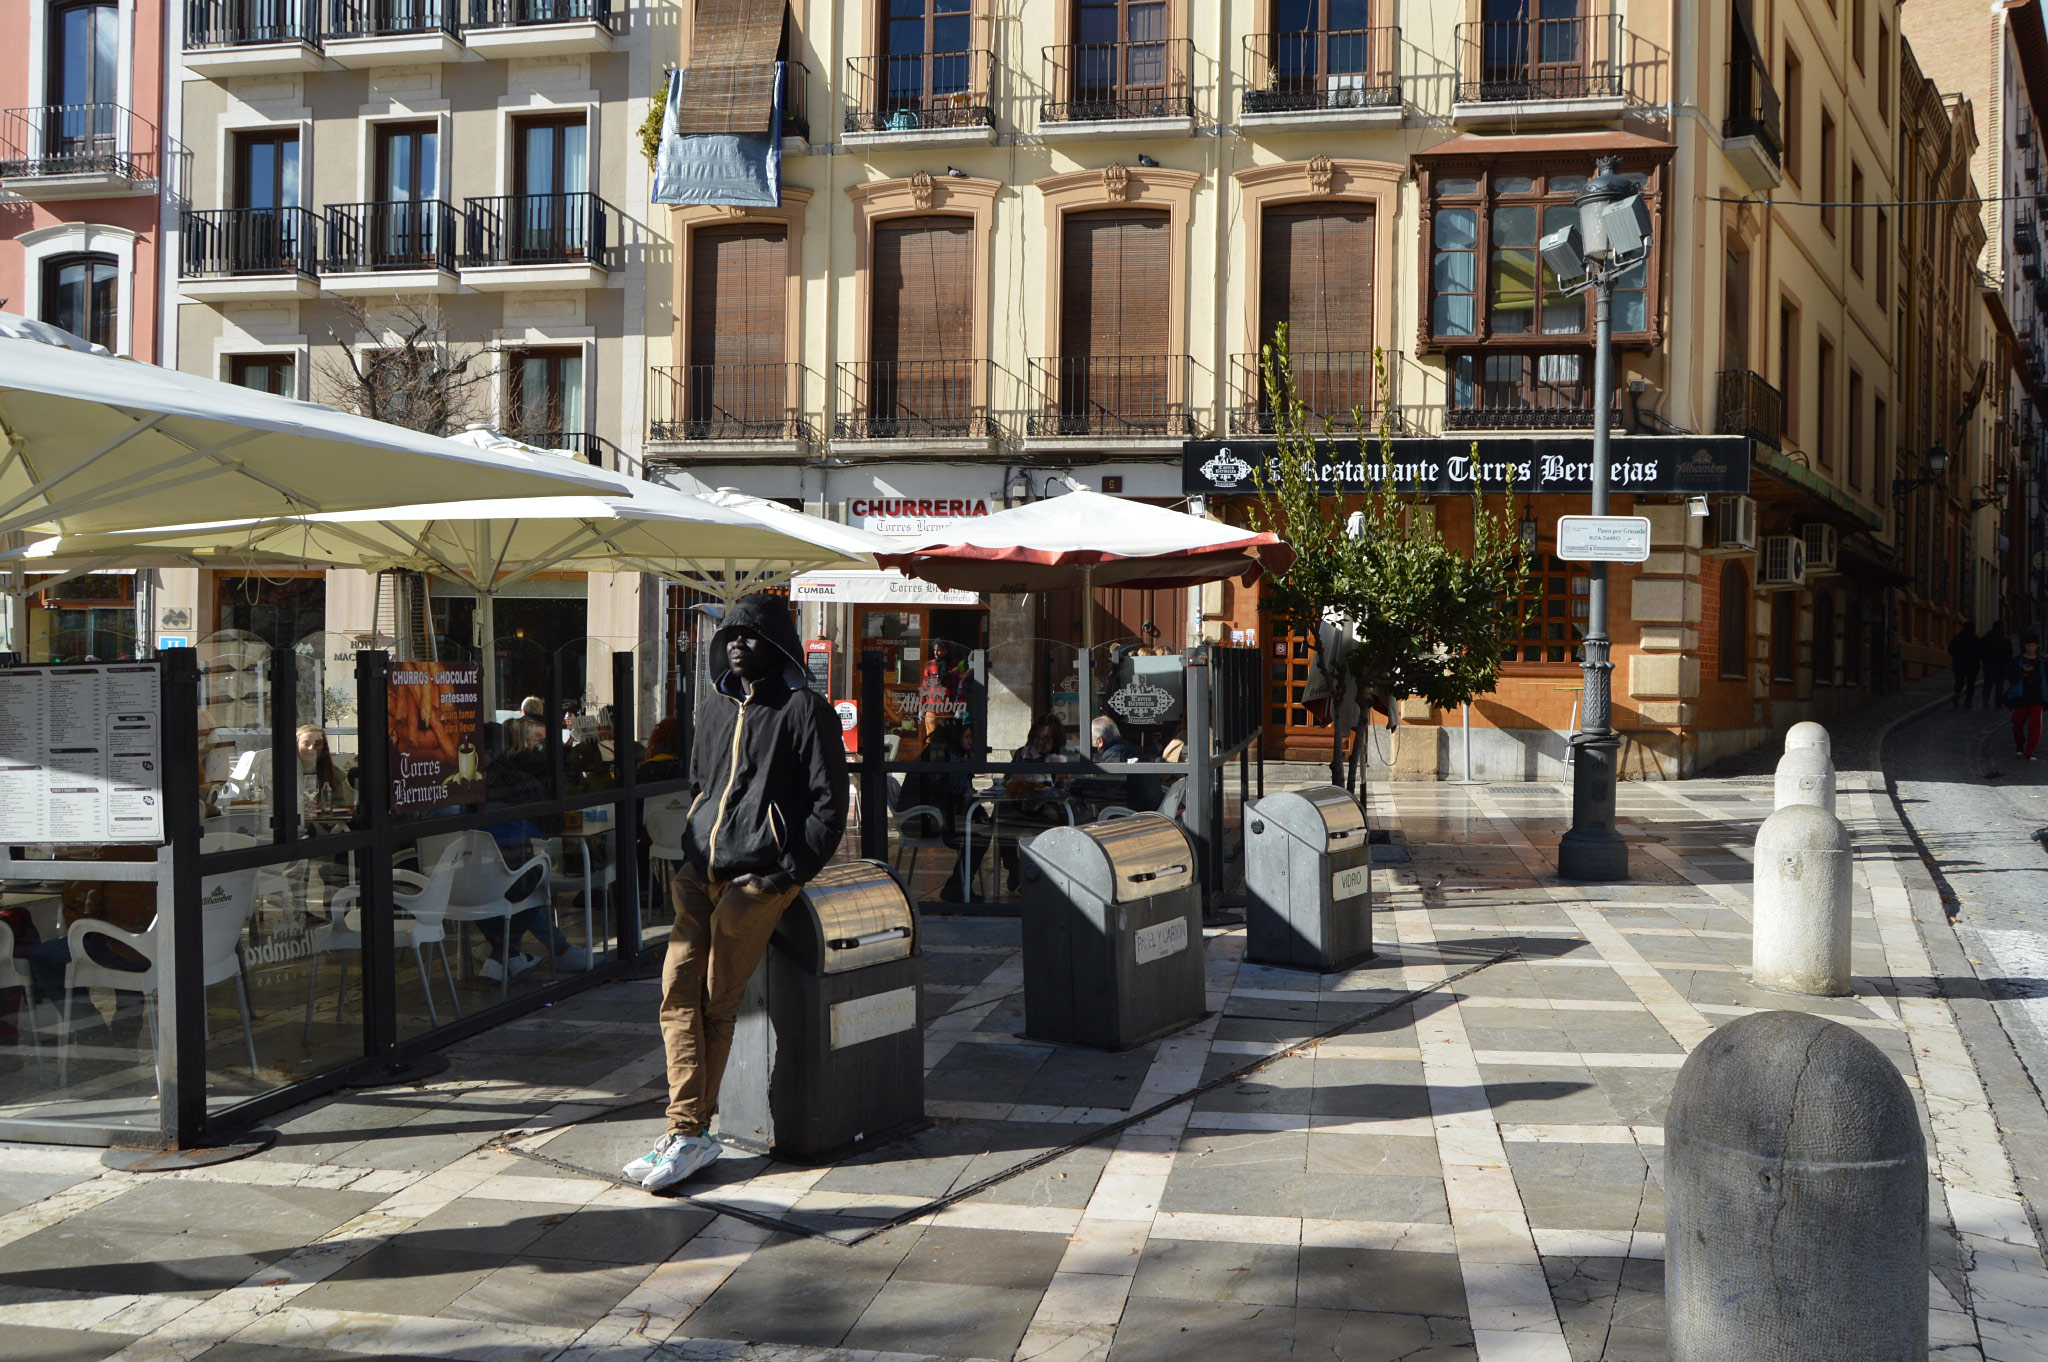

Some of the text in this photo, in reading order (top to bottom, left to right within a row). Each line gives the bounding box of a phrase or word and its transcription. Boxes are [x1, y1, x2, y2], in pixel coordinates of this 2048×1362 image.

[1540, 454, 1659, 487] Berejas
[1108, 479, 1115, 489] 6
[852, 499, 989, 517] CHURRERIA
[876, 519, 912, 532] Torres
[797, 586, 836, 595] CUMBAL
[889, 581, 923, 593] Torres
[392, 670, 429, 685] CHURROS
[435, 670, 478, 685] CHOCOLATE
[440, 692, 478, 703] artesanos
[896, 695, 968, 714] Alhambra
[458, 710, 476, 719] tomar
[459, 722, 476, 733] llevar
[400, 752, 440, 779] Torres
[393, 778, 449, 806] Bermejas
[1341, 871, 1362, 889] VIDRIO
